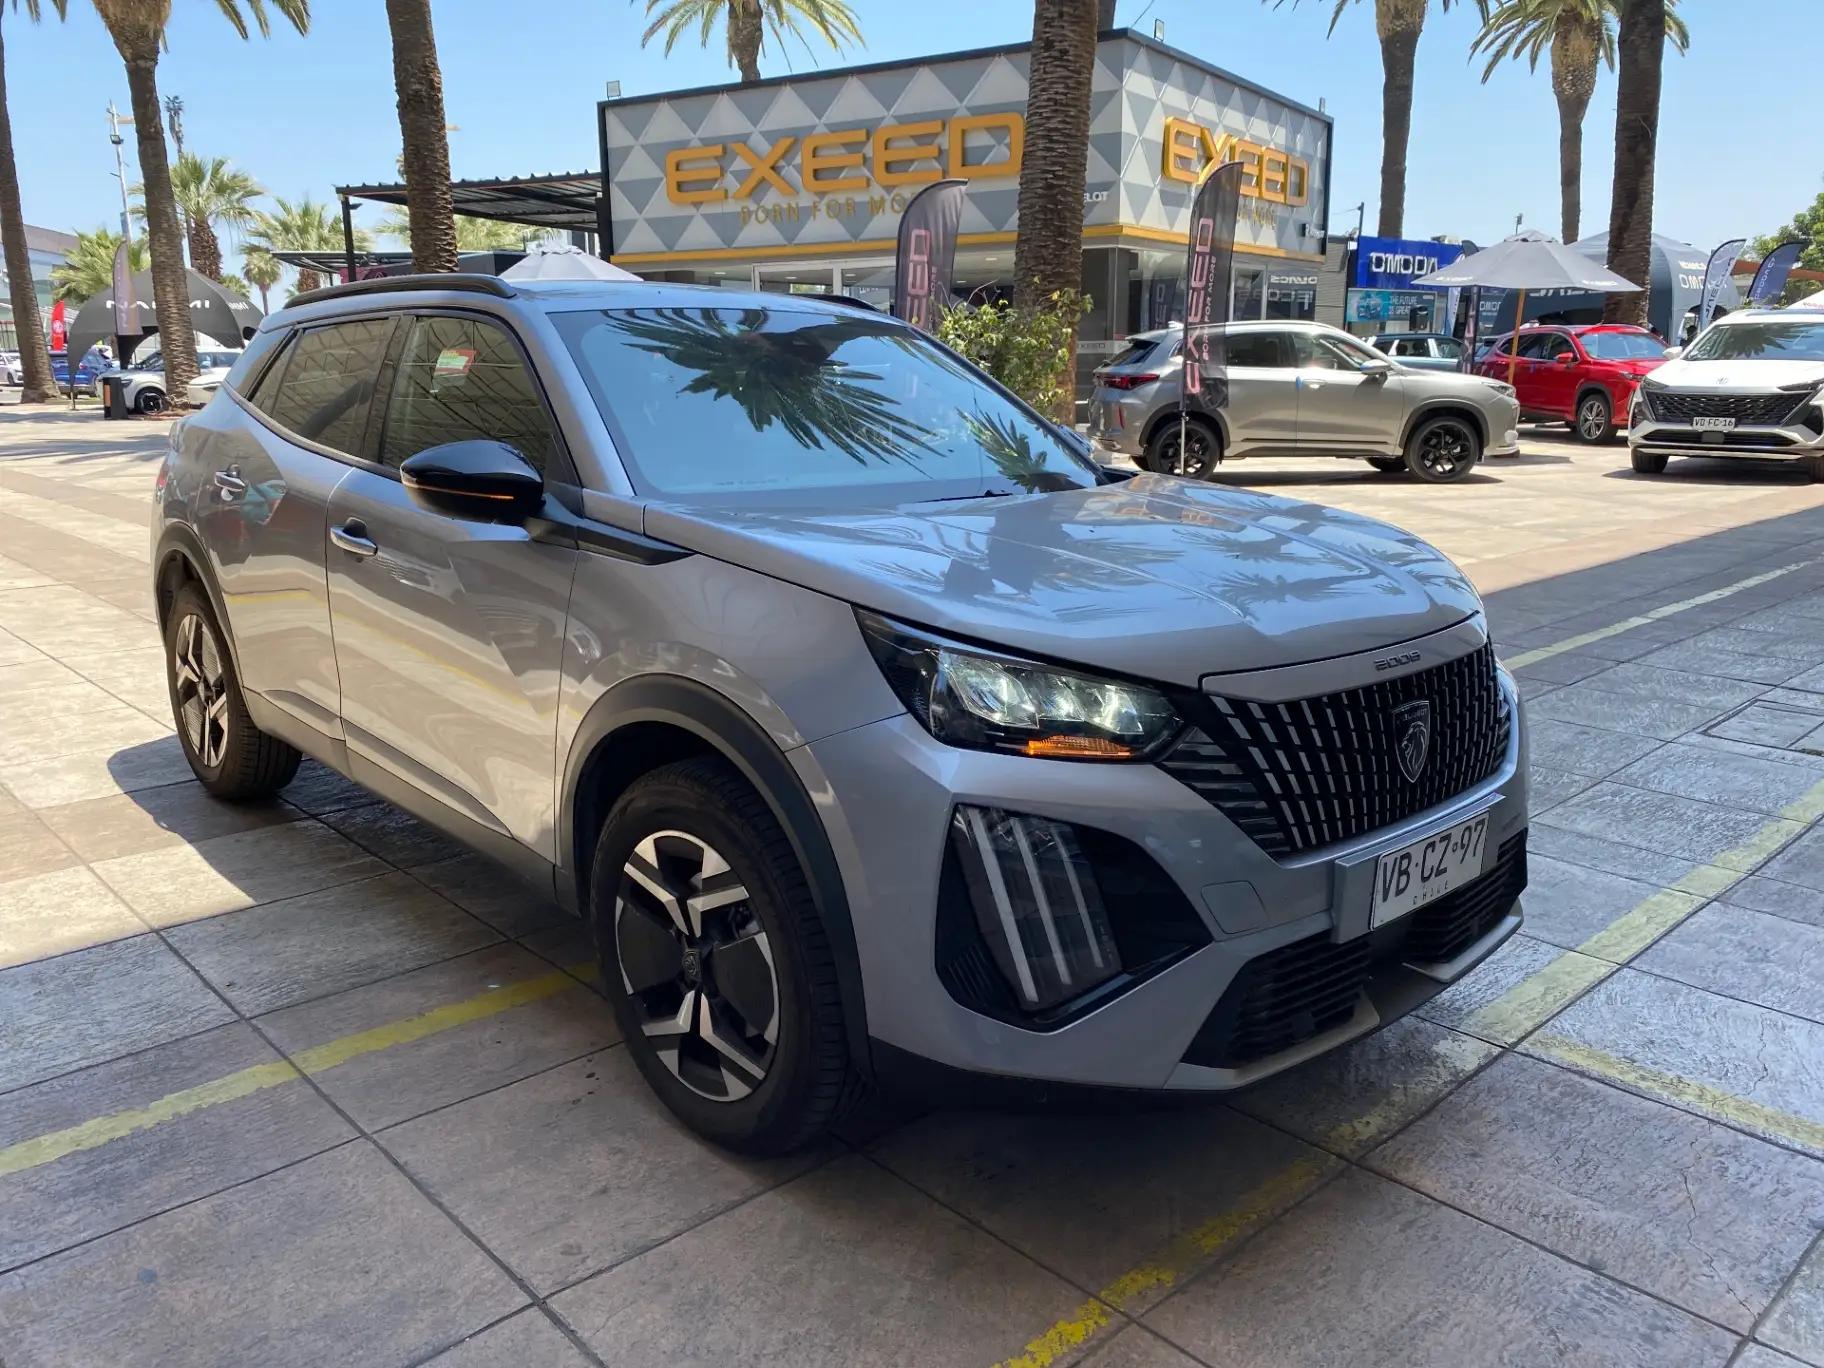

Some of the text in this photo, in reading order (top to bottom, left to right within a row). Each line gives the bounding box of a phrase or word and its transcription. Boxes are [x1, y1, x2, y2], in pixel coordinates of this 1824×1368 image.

[665, 112, 1025, 204] EXEED
[739, 202, 800, 225] BORN
[811, 196, 857, 221] FOR
[1208, 255, 1217, 294] MORE
[1370, 252, 1439, 275] OMODA
[1373, 650, 1421, 671] 2008
